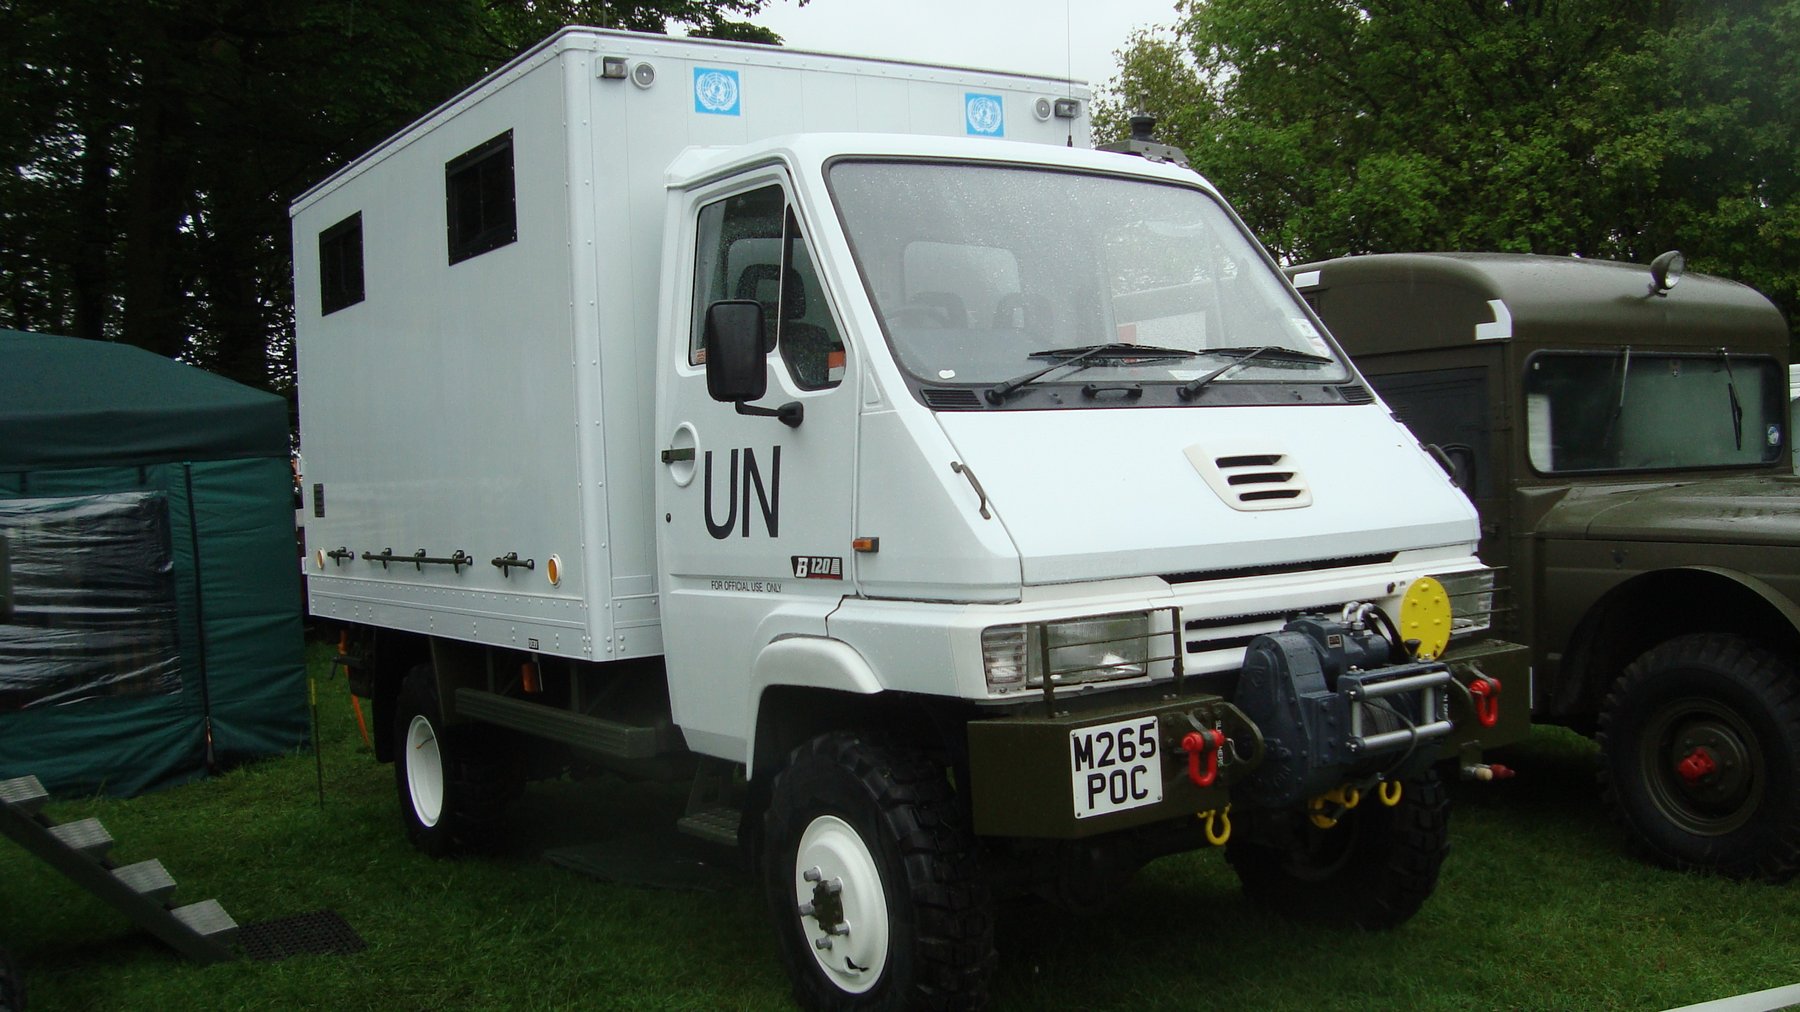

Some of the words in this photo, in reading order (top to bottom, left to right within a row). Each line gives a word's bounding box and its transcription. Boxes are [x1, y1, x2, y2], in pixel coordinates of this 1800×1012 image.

[704, 445, 781, 540] UN
[711, 580, 723, 591] FOR
[724, 581, 750, 592] OFFICIAL
[751, 582, 763, 593] USE
[766, 582, 782, 593] ONLY
[1073, 722, 1157, 772] M265
[1087, 765, 1149, 810] POC
